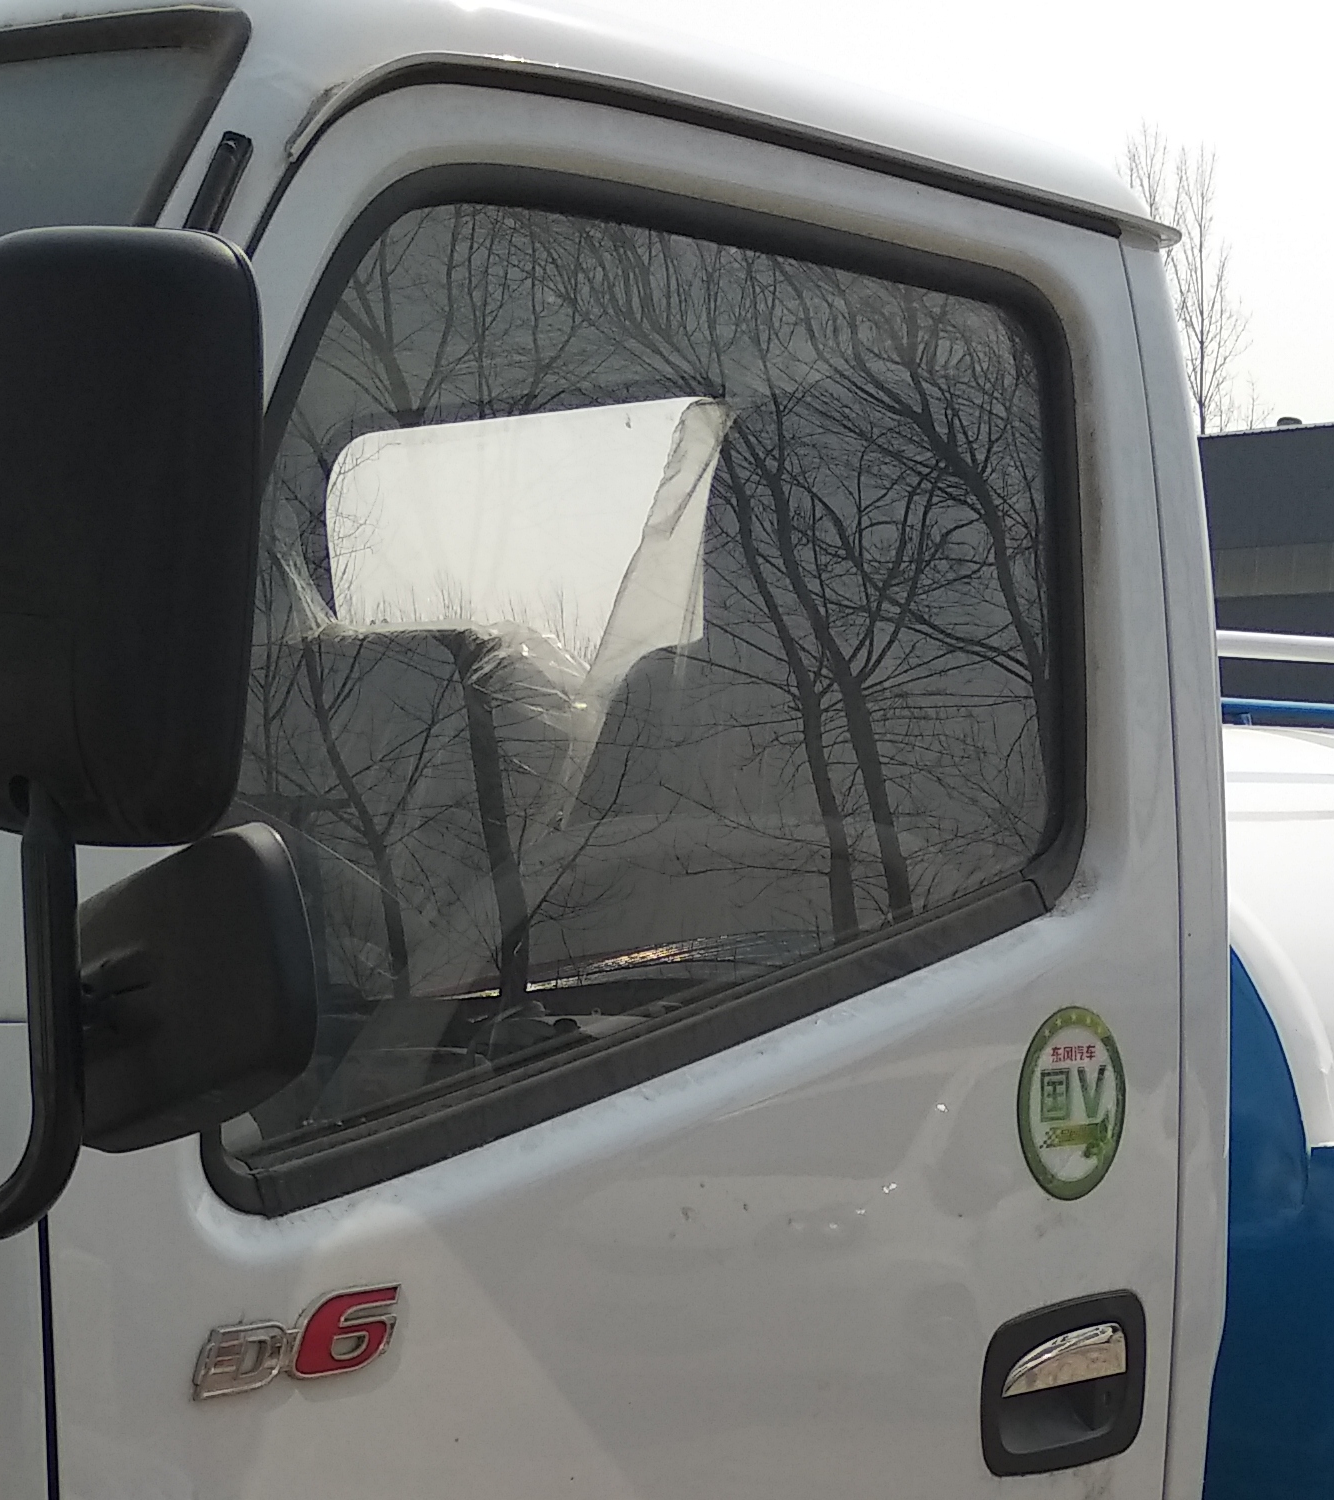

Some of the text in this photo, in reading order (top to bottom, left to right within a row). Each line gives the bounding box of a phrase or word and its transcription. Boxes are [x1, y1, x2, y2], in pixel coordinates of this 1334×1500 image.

[1050, 1044, 1097, 1064] 东风汽车
[190, 1281, 402, 1401] D6
